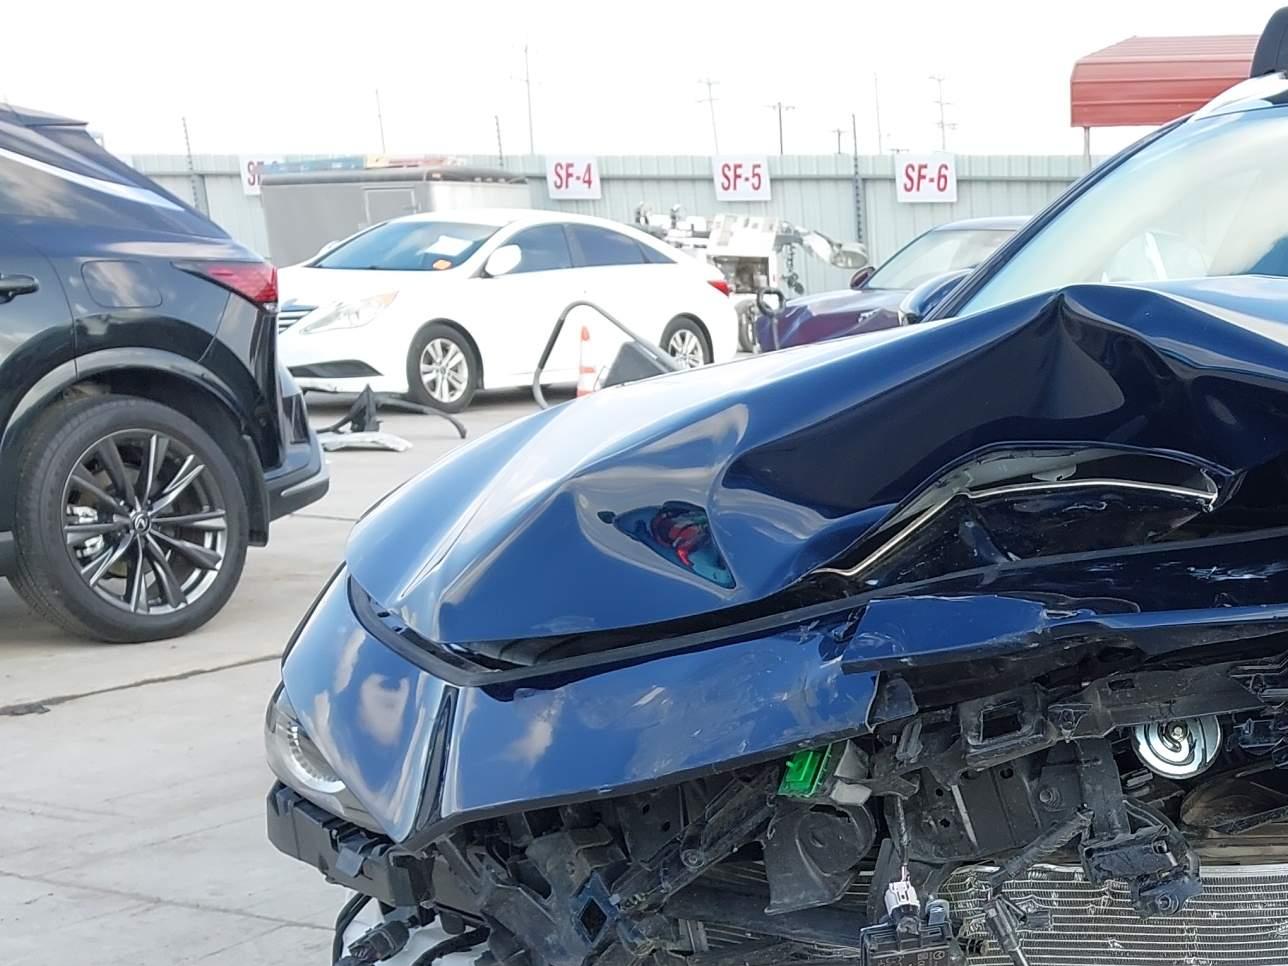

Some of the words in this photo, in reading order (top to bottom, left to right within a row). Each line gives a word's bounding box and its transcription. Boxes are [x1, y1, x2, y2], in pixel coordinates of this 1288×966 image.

[553, 162, 593, 190] SF-4
[720, 163, 762, 191] SF-5
[903, 163, 949, 192] SF-6
